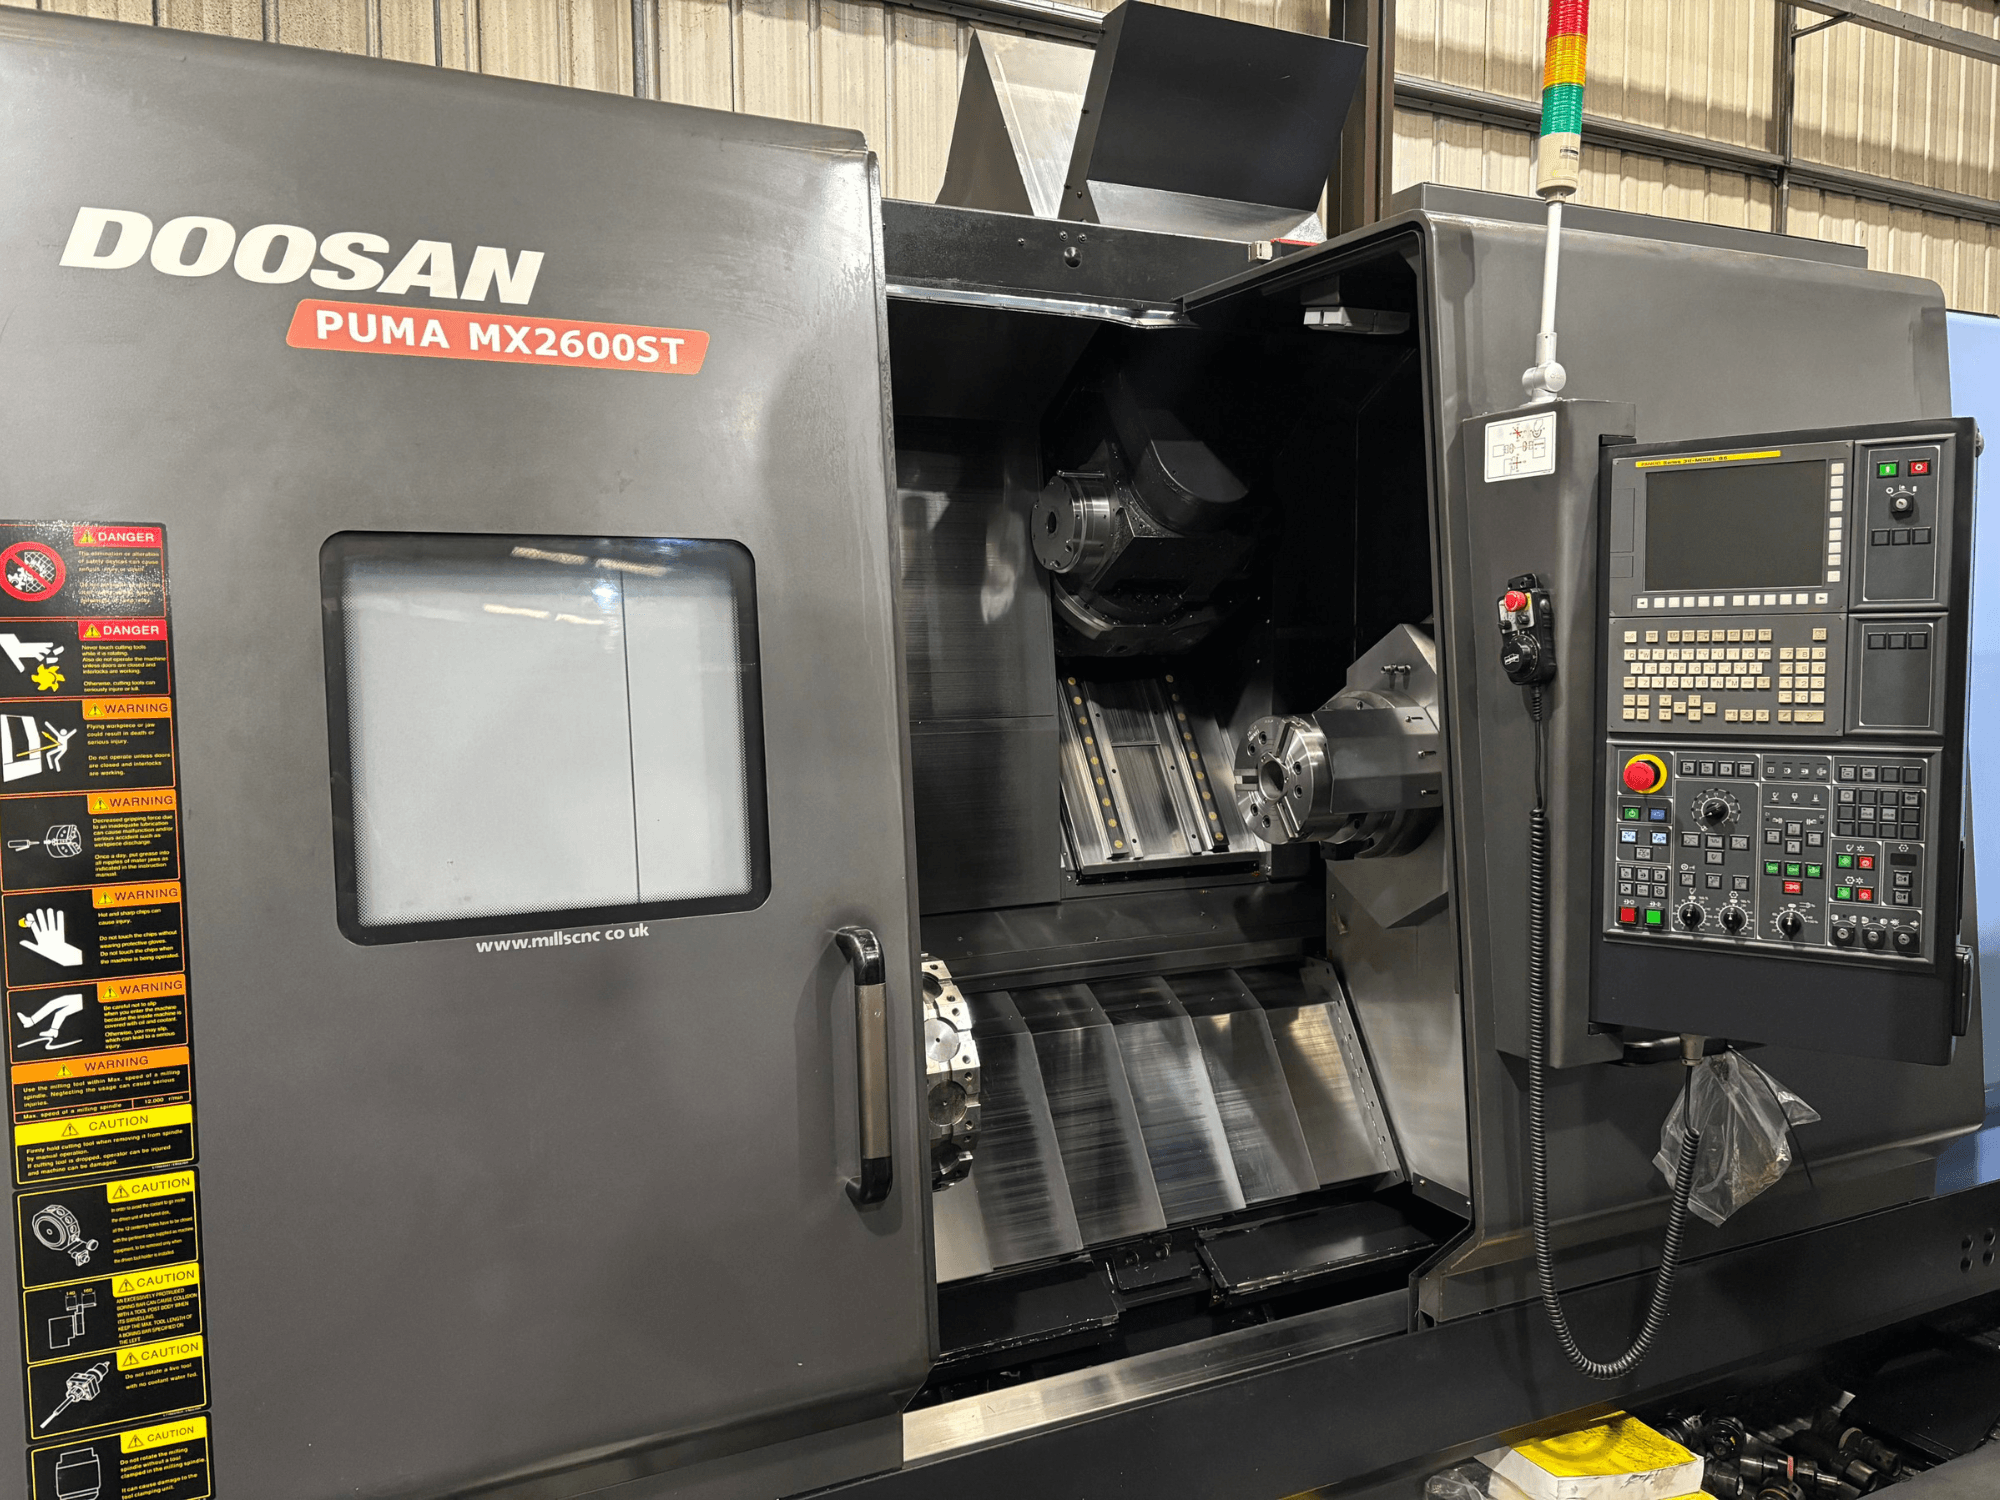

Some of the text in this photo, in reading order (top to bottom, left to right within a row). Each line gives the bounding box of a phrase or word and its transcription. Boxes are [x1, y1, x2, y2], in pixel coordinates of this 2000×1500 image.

[59, 206, 544, 305] DOOSAN
[316, 310, 684, 365] PUMA MX2600ST
[98, 532, 154, 542] DANGER
[103, 626, 159, 635] DANGER
[105, 703, 168, 713] WARNING
[110, 796, 173, 807] WARNING
[115, 888, 178, 901] WARNING
[629, 923, 649, 938] uk
[120, 980, 182, 994] WARNING
[85, 1056, 148, 1071] WARNING
[89, 1115, 148, 1131] CAUTION
[132, 1177, 190, 1194] CAUTION
[137, 1270, 194, 1287] CAUTION
[141, 1342, 199, 1360] CAUTION
[147, 1426, 194, 1442] CAUTION
[121, 1470, 146, 1479] clamped
[134, 1488, 161, 1497] clamping
